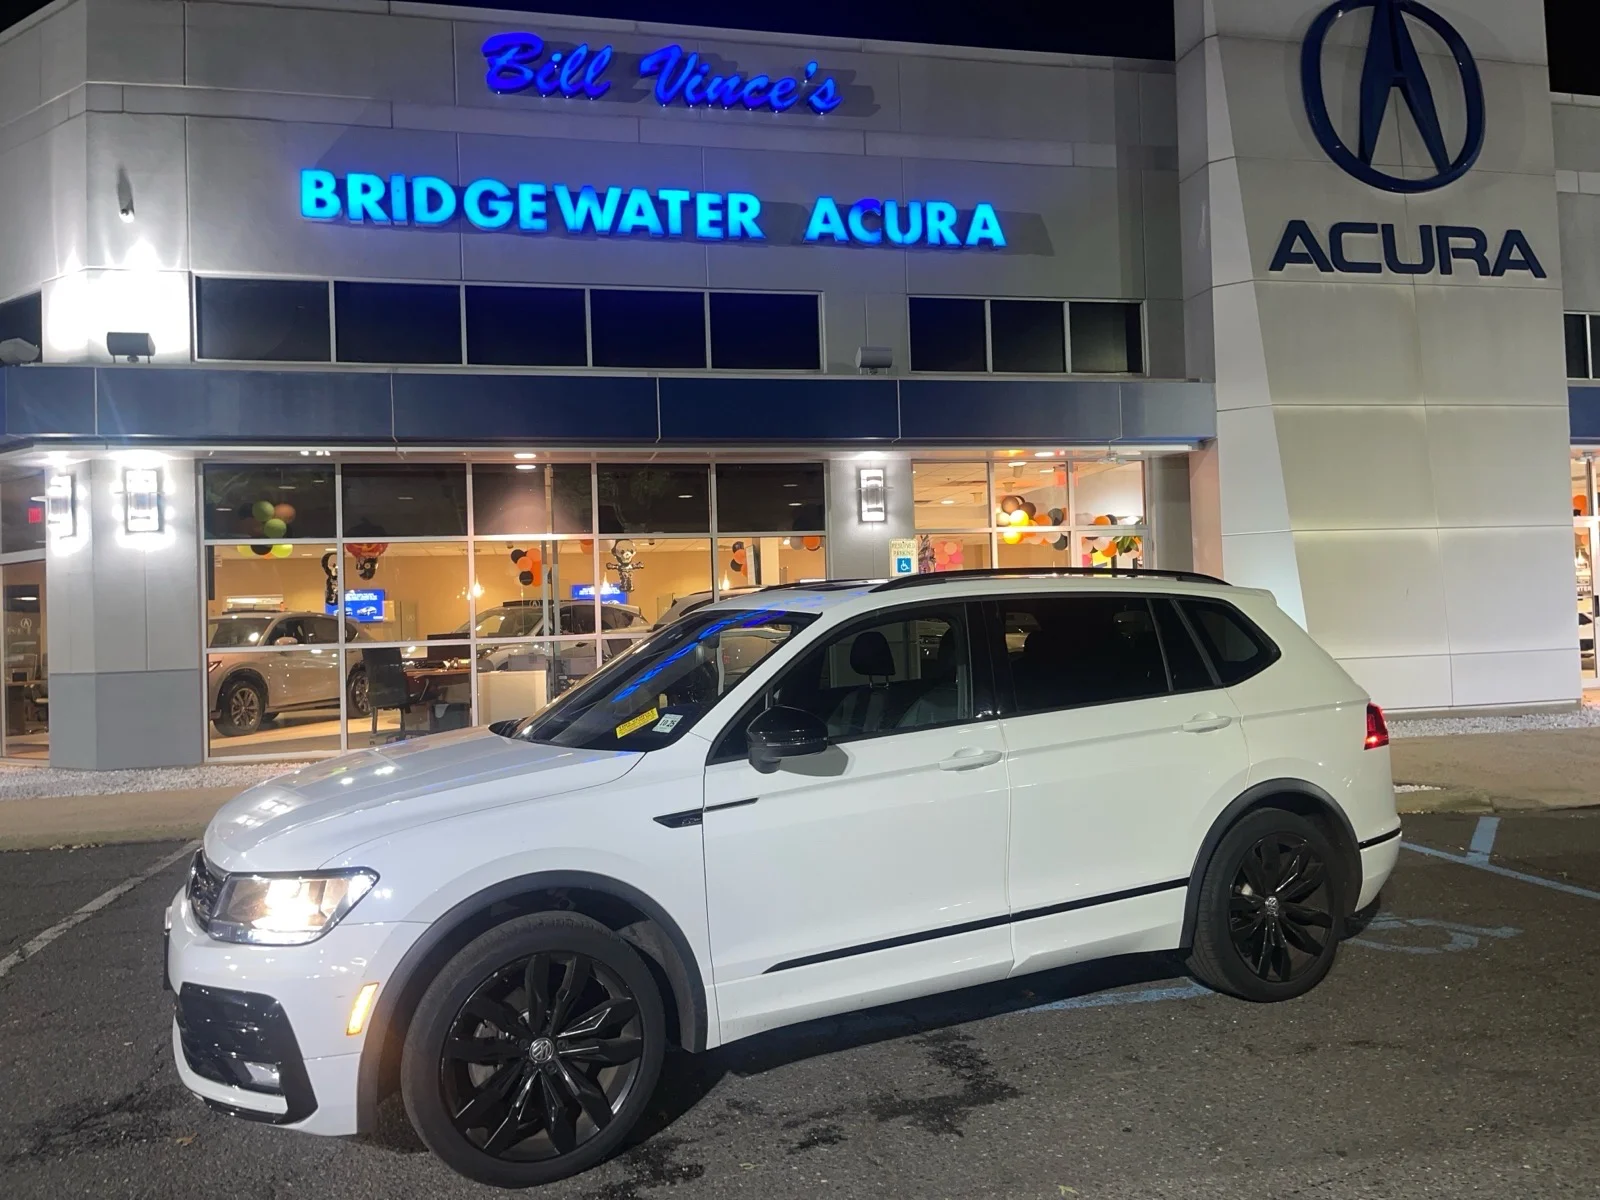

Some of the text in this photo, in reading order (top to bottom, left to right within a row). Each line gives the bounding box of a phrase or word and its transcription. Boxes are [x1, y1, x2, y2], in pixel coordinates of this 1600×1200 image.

[481, 32, 843, 115] Bill Vince's
[300, 169, 1007, 248] BRIDGEWATER ACURA
[1269, 219, 1547, 279] ACURA
